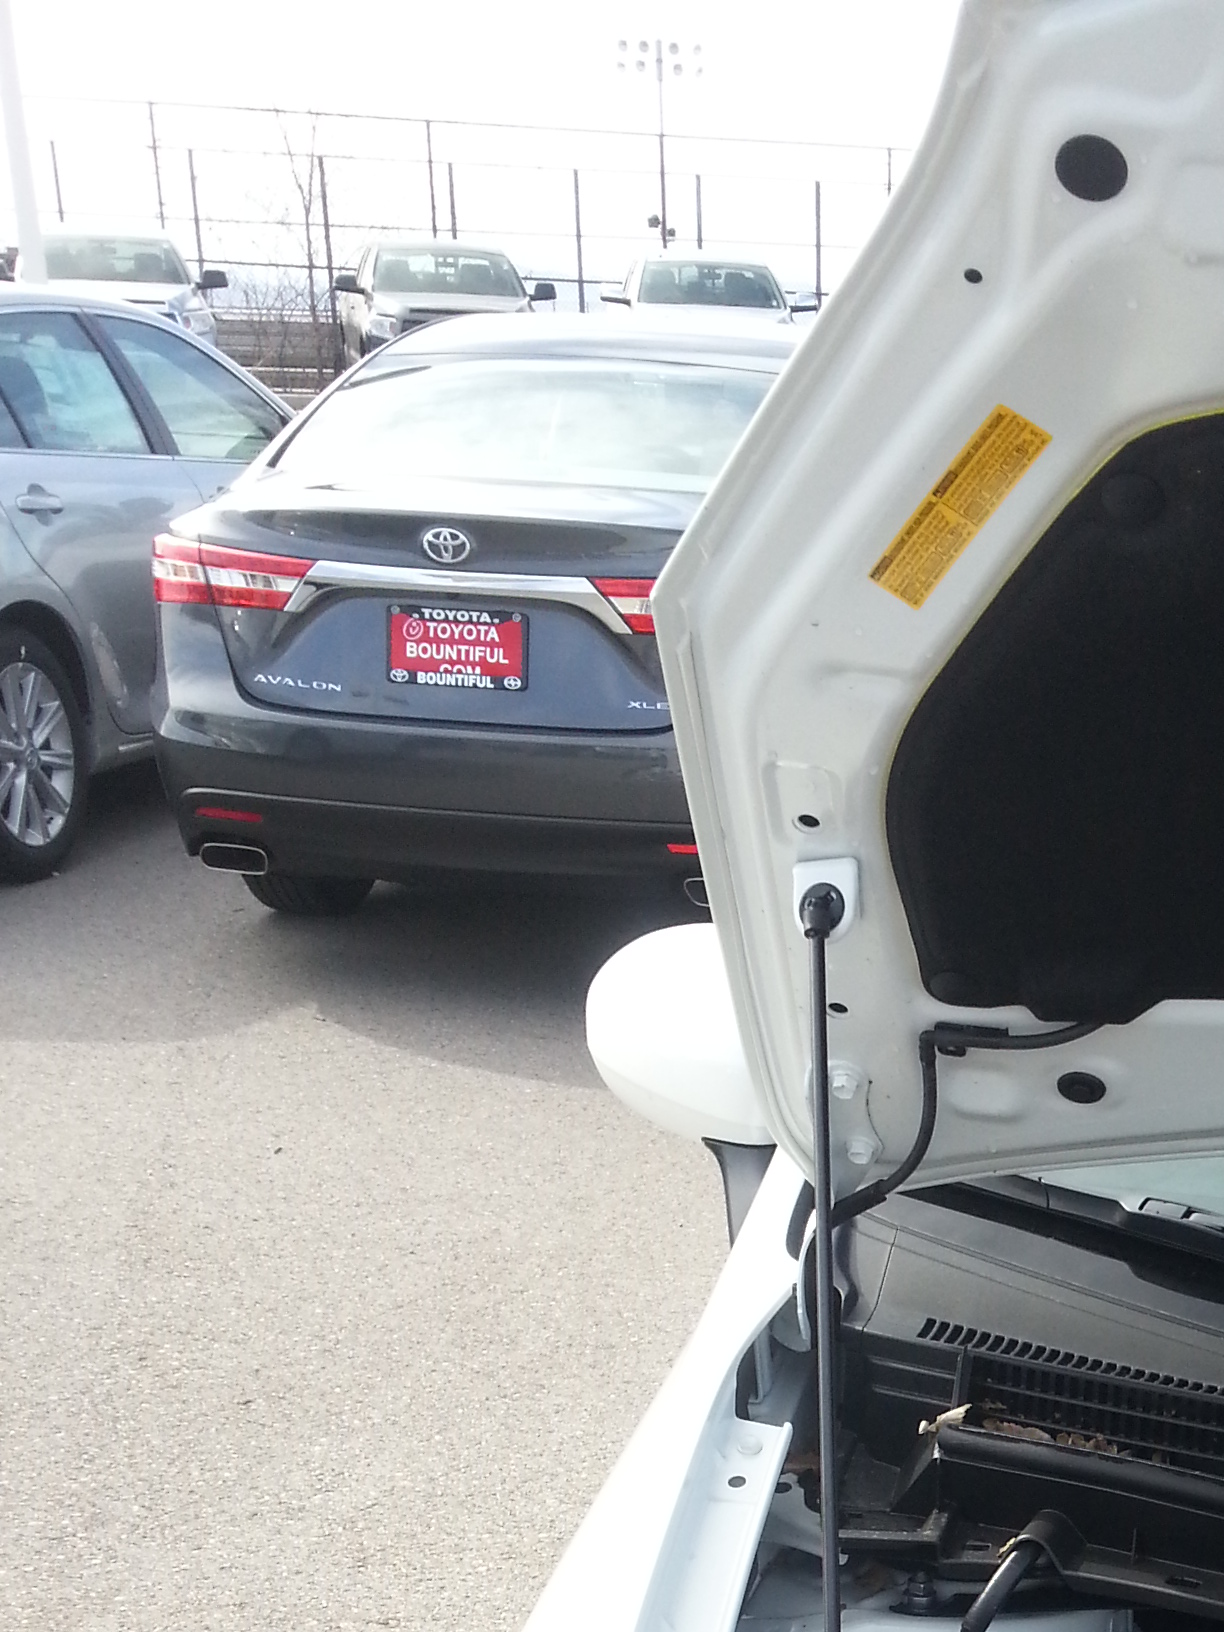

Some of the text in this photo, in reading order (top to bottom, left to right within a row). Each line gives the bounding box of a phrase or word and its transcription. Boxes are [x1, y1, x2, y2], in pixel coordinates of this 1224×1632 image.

[421, 608, 491, 623] TOYOTA
[426, 622, 499, 642] TOYOTA
[406, 642, 508, 664] BOUNTIFUL
[254, 674, 342, 692] AVALON
[417, 671, 494, 688] BOUNTIFUL
